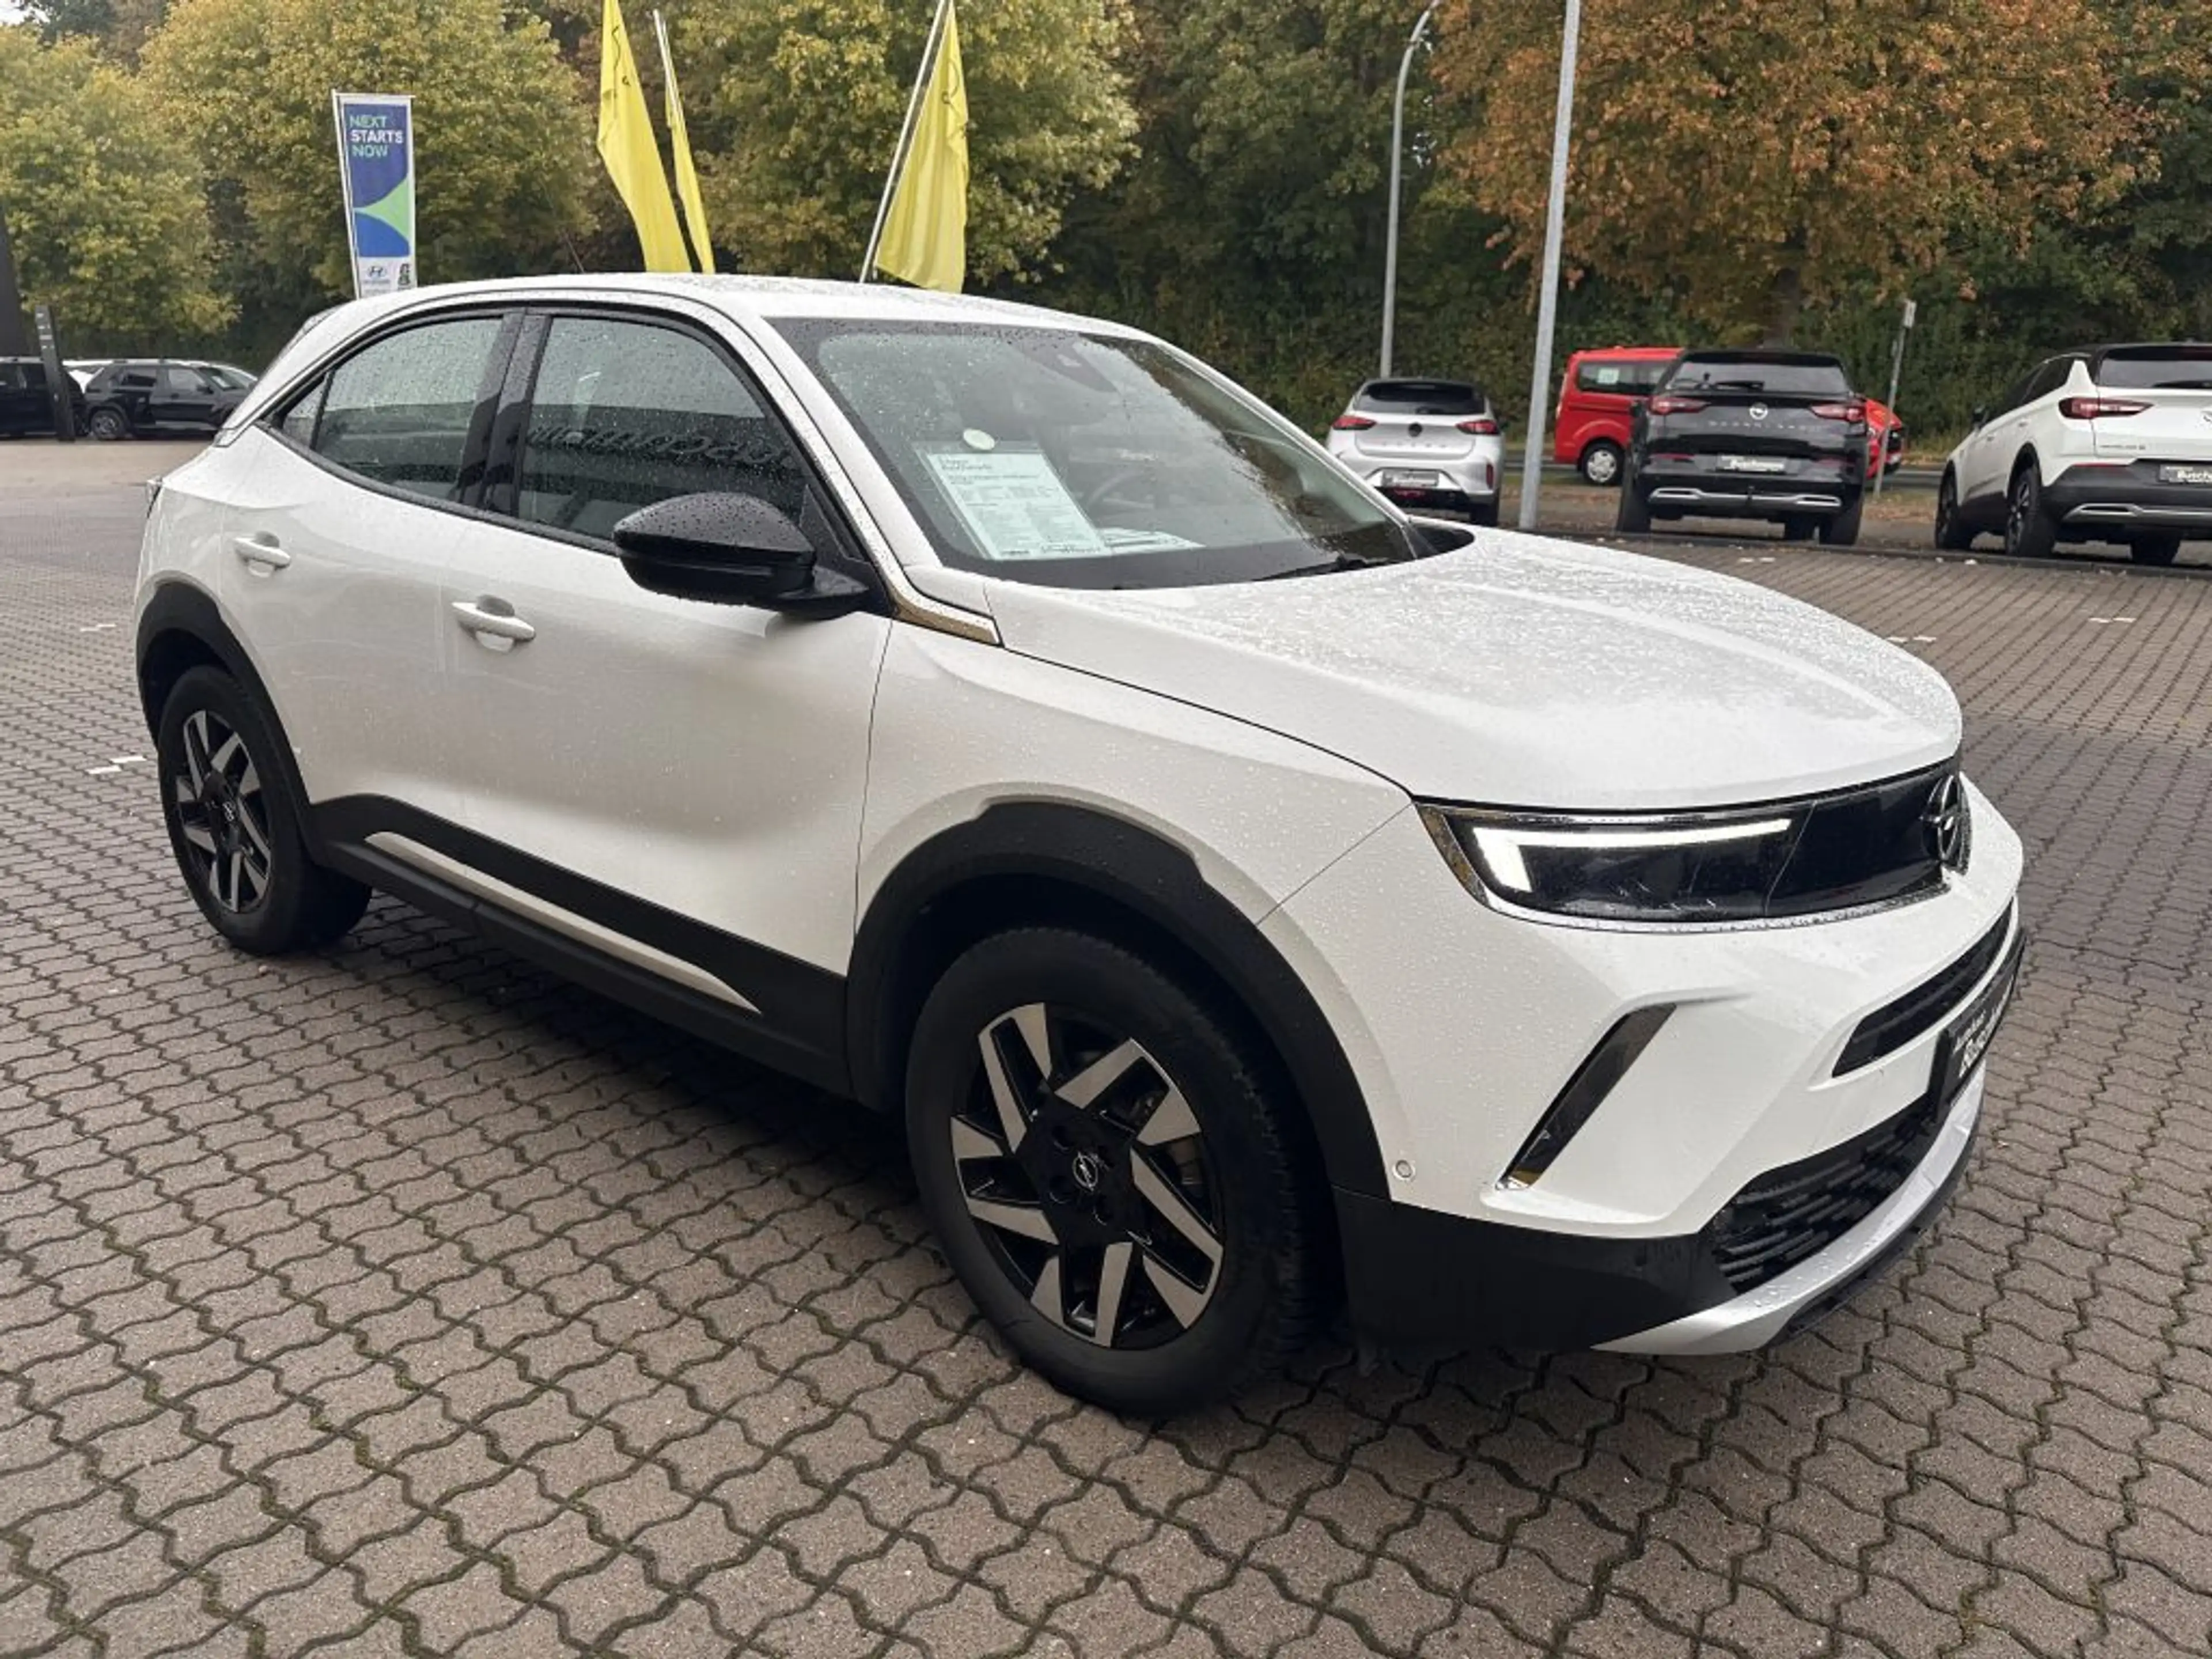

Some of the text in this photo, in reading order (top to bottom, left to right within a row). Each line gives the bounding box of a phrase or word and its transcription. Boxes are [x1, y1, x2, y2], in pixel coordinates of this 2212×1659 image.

[350, 115, 387, 128] NEXT
[351, 130, 403, 144] STARTS
[352, 145, 388, 158] NOW
